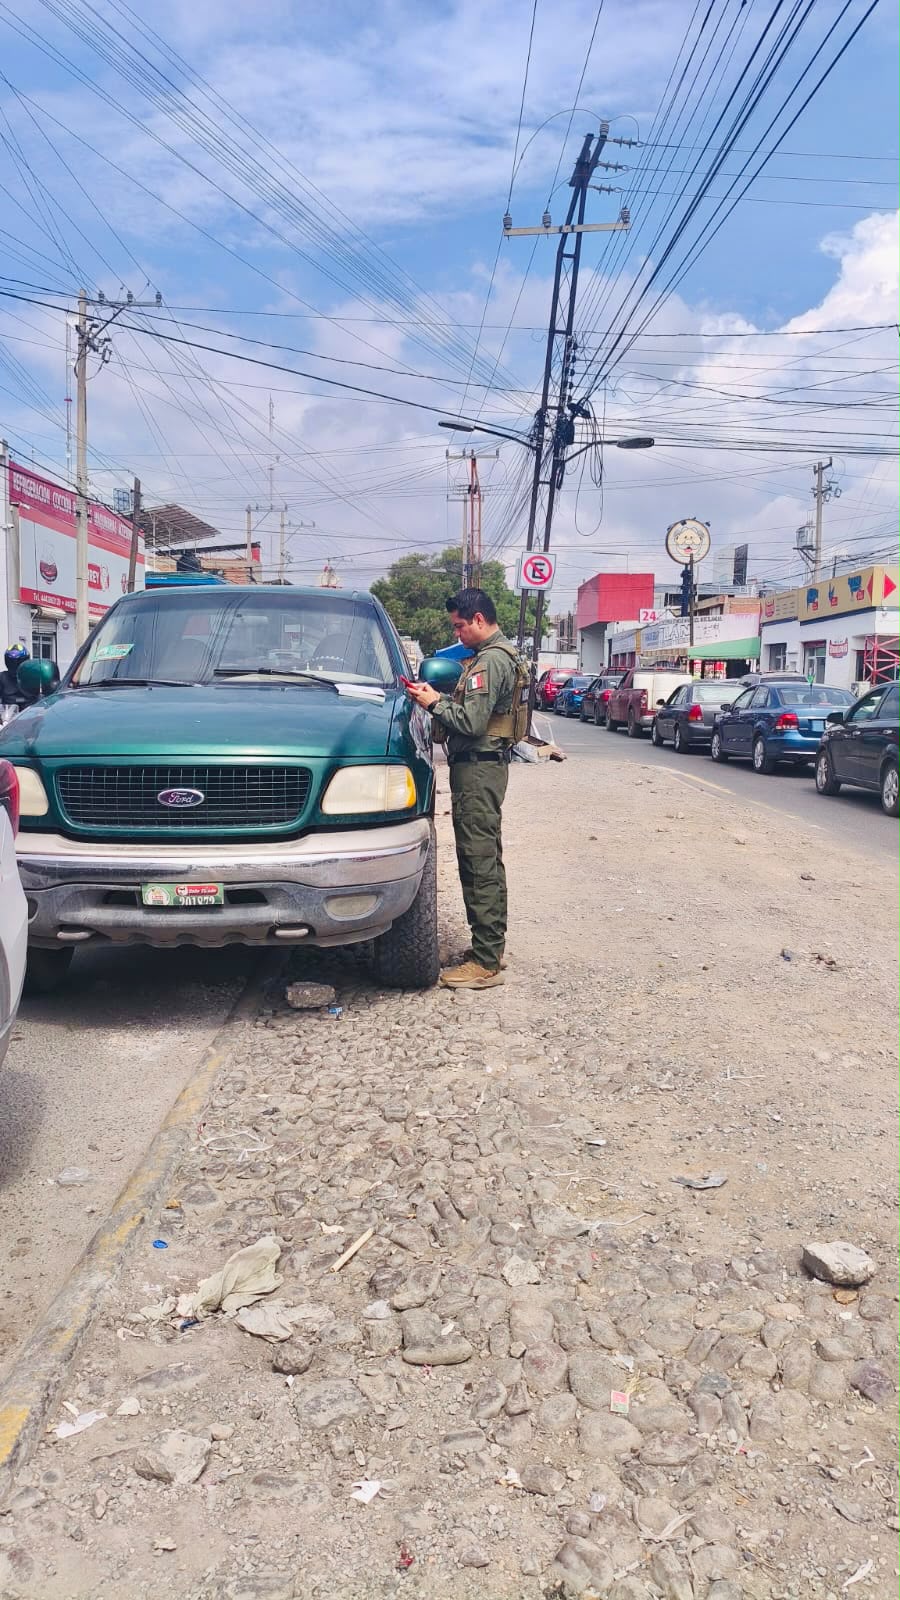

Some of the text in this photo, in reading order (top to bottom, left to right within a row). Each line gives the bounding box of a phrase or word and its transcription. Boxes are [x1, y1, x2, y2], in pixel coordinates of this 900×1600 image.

[532, 562, 545, 580] E
[642, 610, 657, 621] 24
[168, 791, 194, 804] Ford
